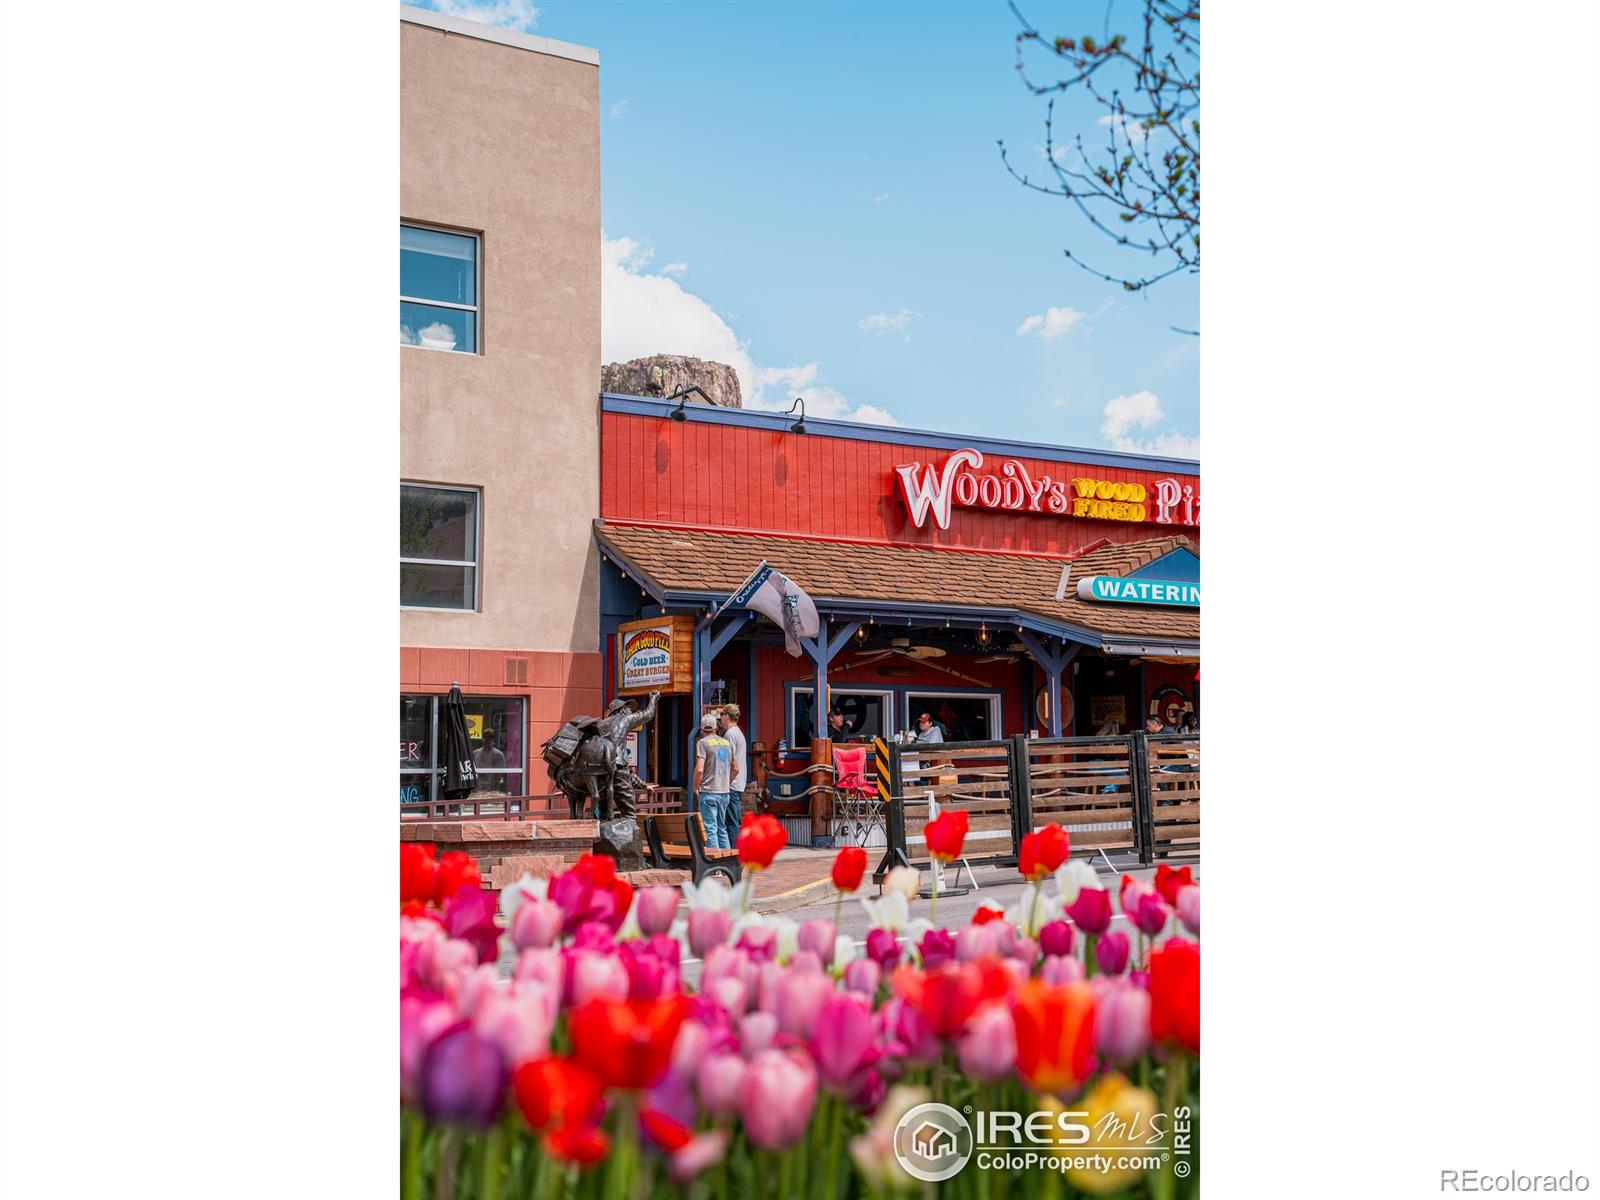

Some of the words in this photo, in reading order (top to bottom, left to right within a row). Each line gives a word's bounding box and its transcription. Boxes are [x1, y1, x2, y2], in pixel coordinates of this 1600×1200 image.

[1072, 477, 1146, 502] WOOD
[1072, 498, 1147, 522] FIRED
[1097, 580, 1200, 603] WATERIN
[633, 656, 648, 667] COLD
[649, 654, 666, 666] BEER
[626, 667, 645, 678] GREAT
